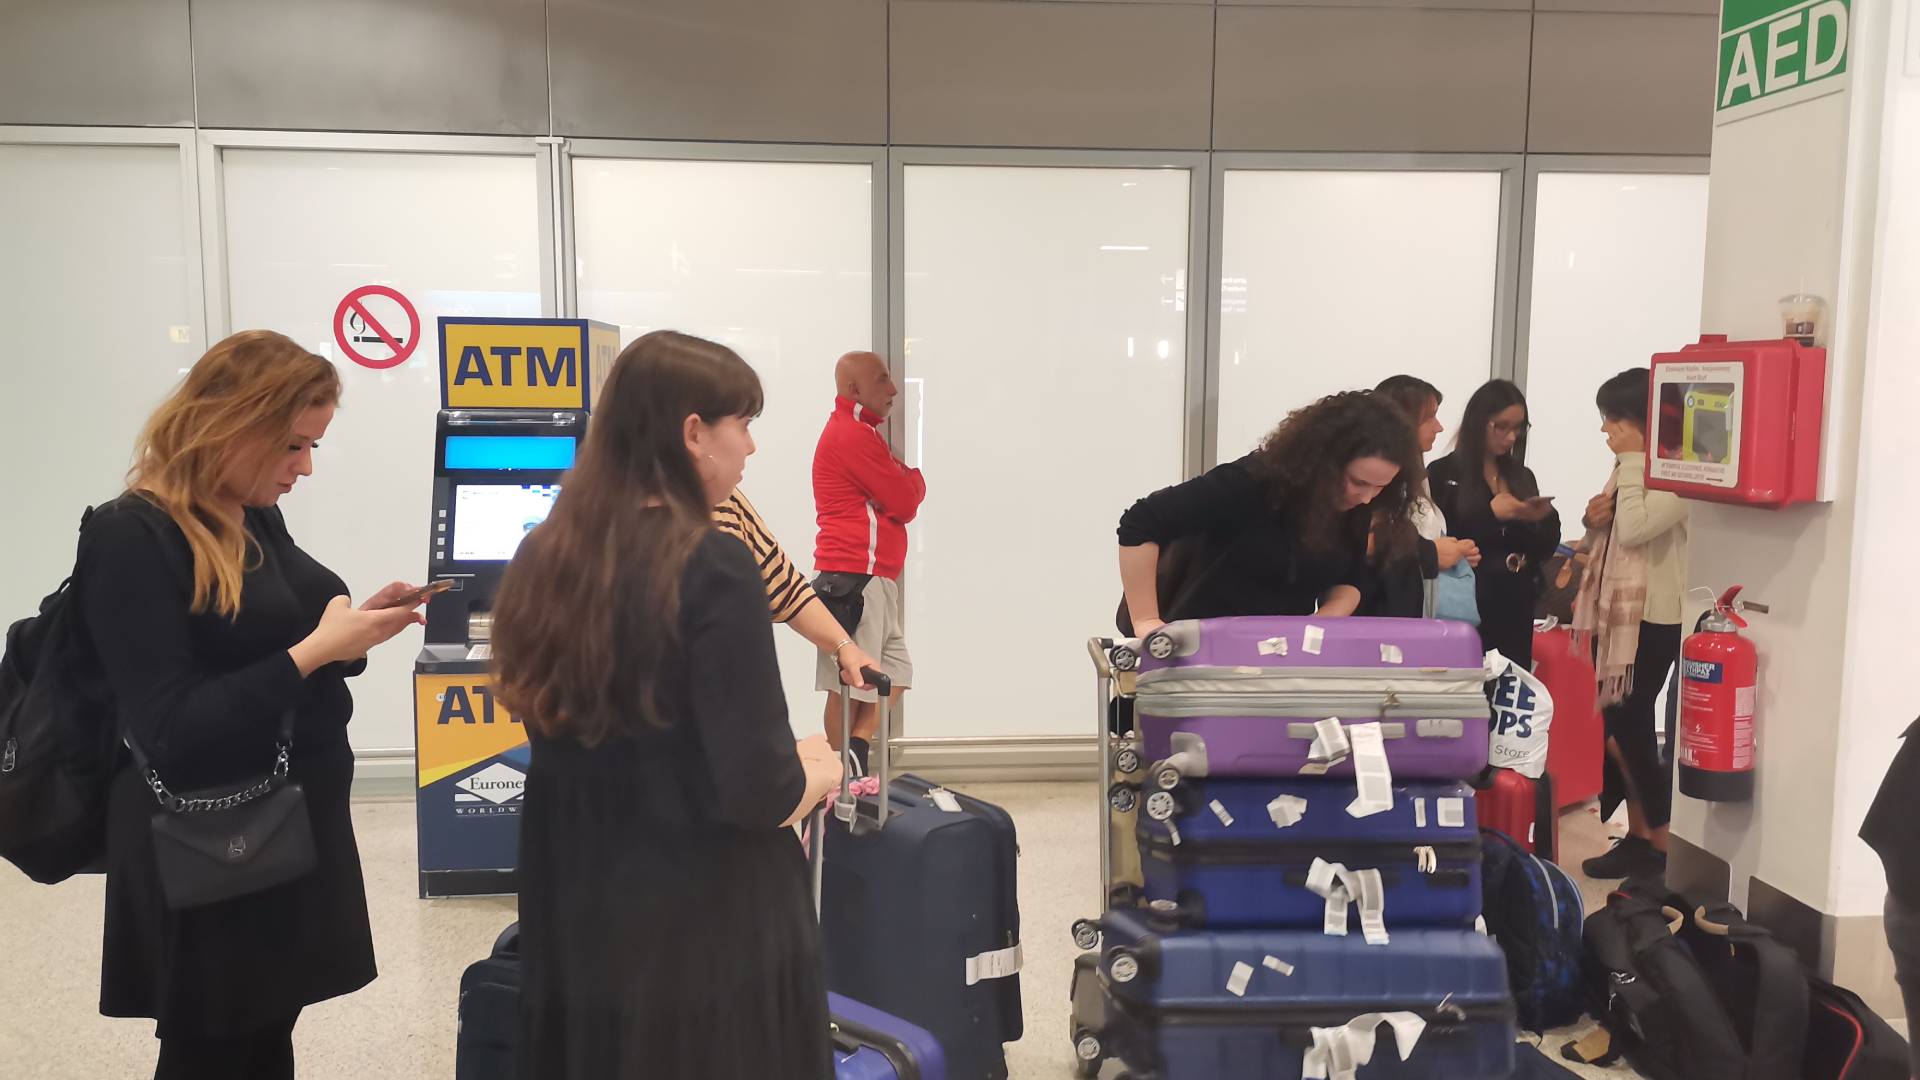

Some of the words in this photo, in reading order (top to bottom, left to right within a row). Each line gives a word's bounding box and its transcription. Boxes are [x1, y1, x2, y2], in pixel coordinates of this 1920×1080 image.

[1721, 0, 1848, 107] AED
[454, 346, 576, 386] ATM
[437, 686, 521, 724] AT
[1494, 675, 1536, 712] EE
[470, 777, 523, 789] Eurone
